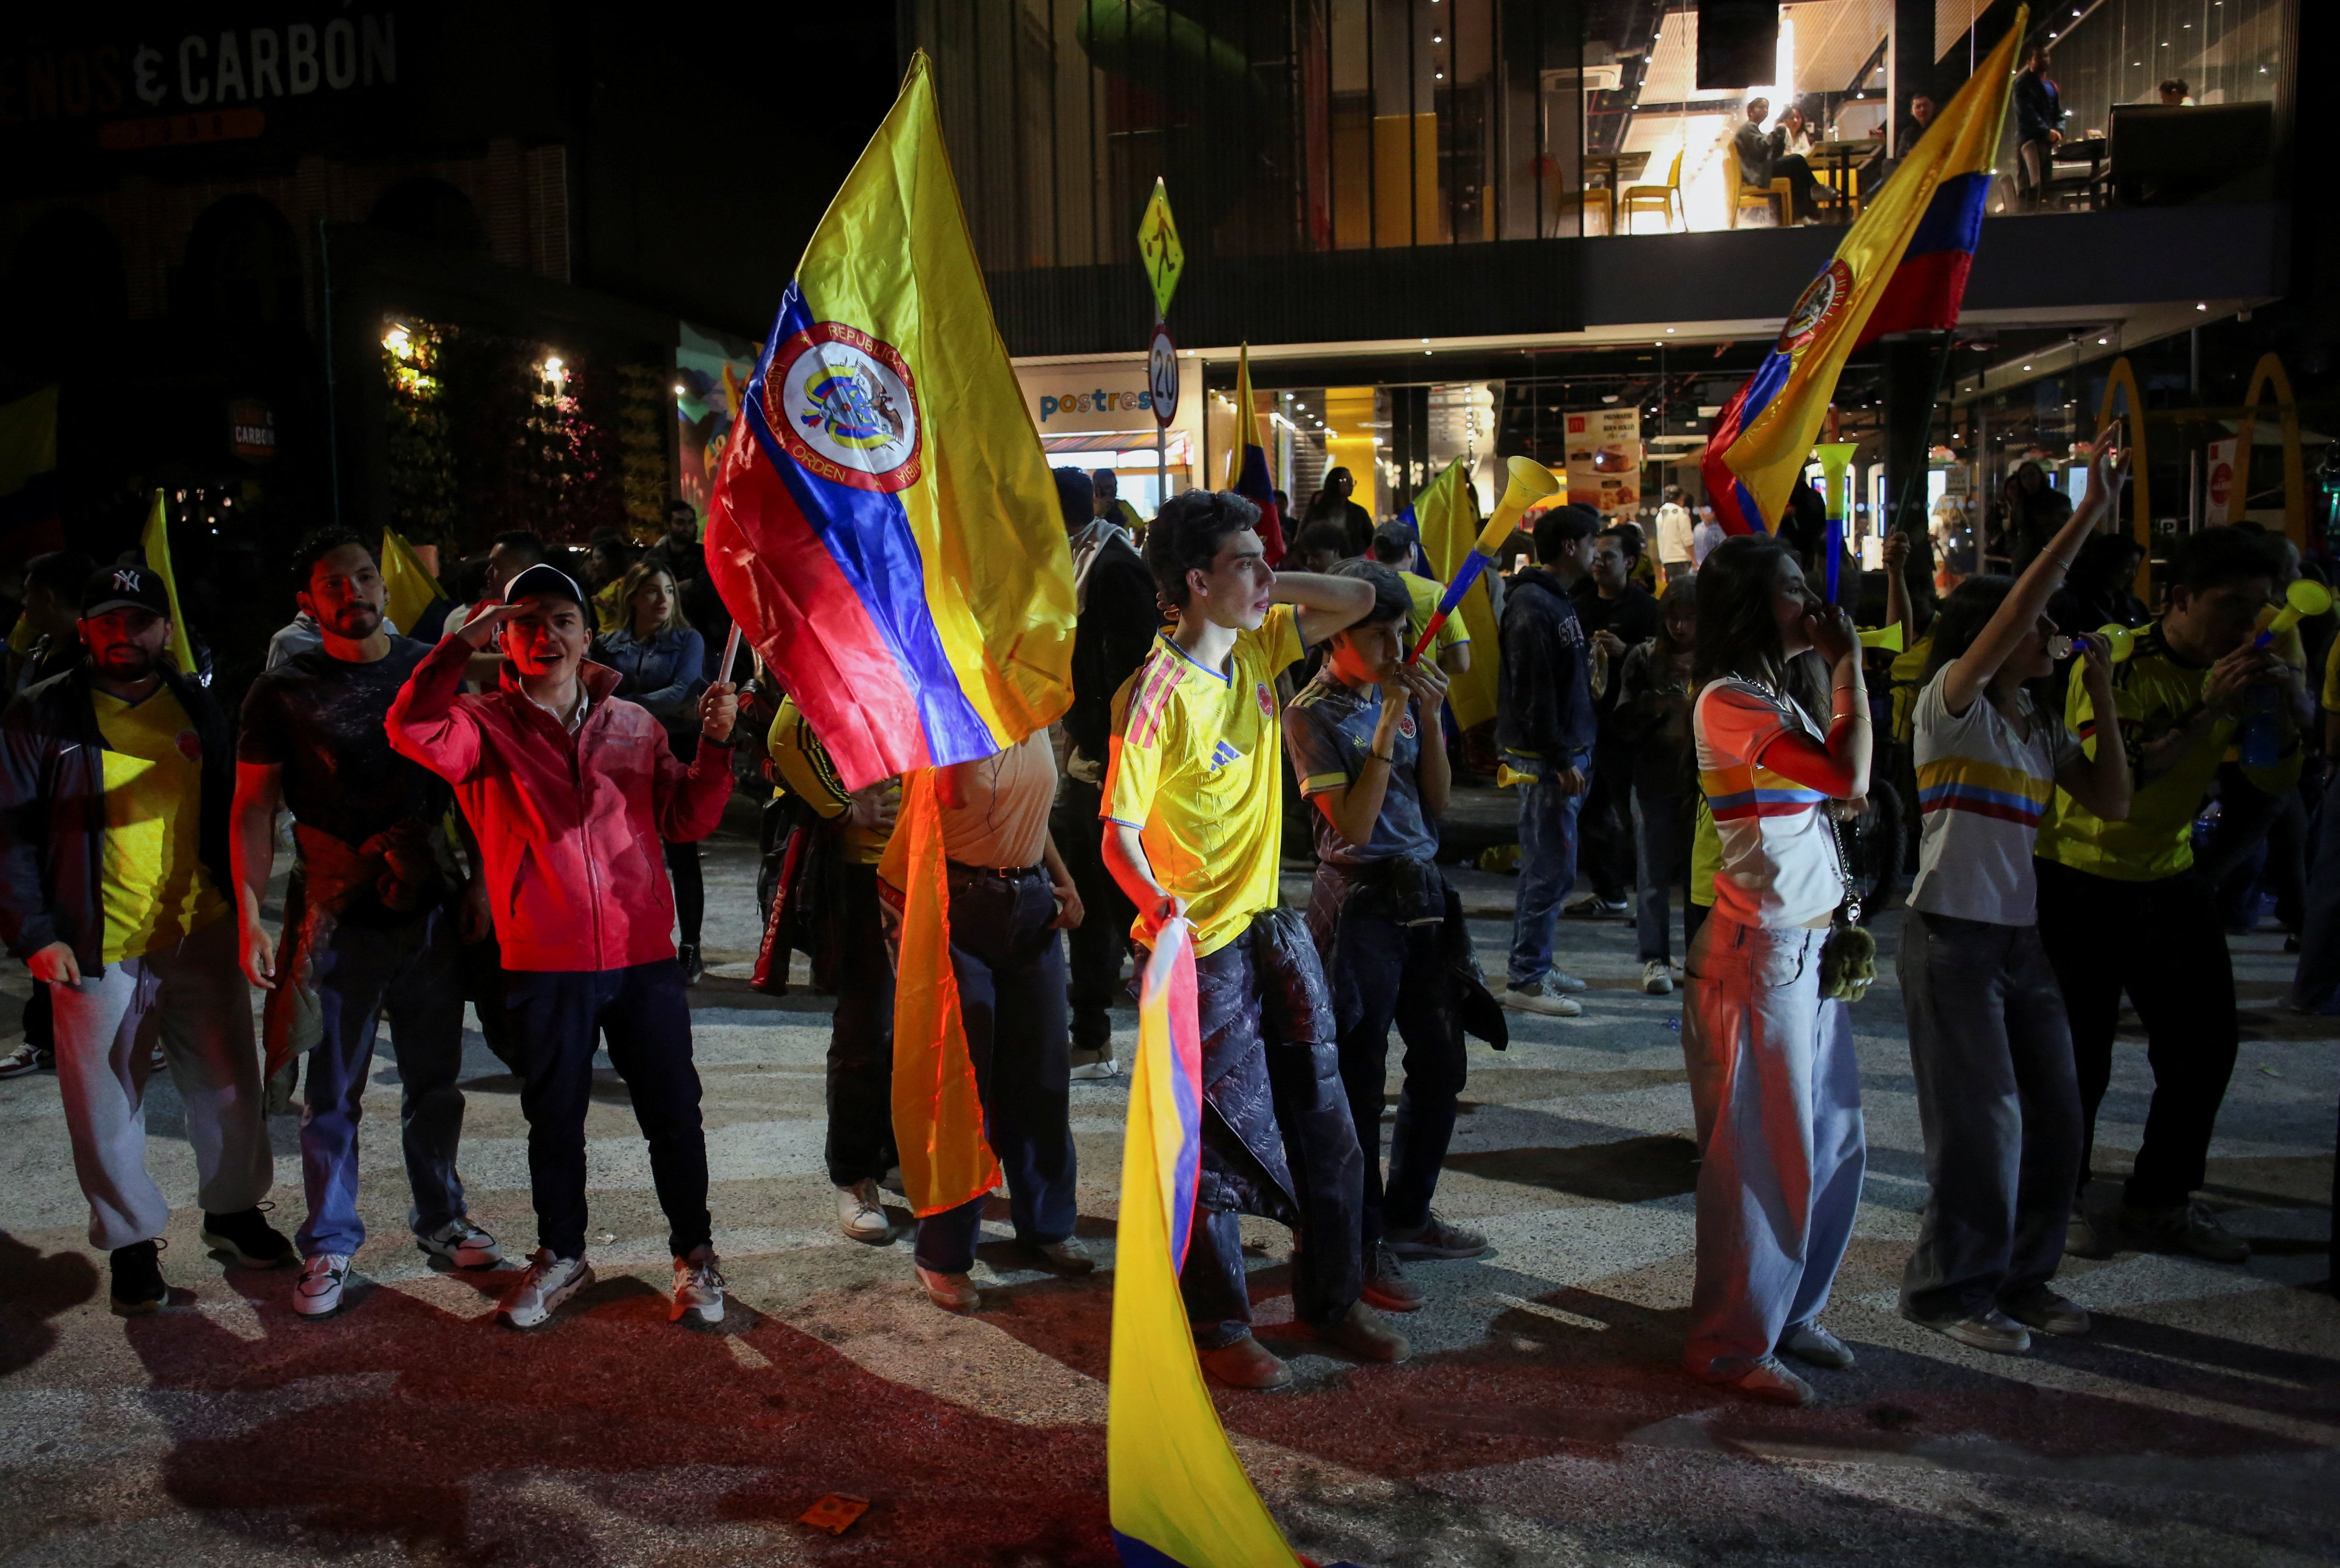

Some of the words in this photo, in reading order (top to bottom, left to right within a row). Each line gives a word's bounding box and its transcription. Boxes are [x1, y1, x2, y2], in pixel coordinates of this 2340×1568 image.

[1155, 349, 1174, 400] 20
[1040, 389, 1152, 422] postres
[792, 445, 846, 483] ORDEN
